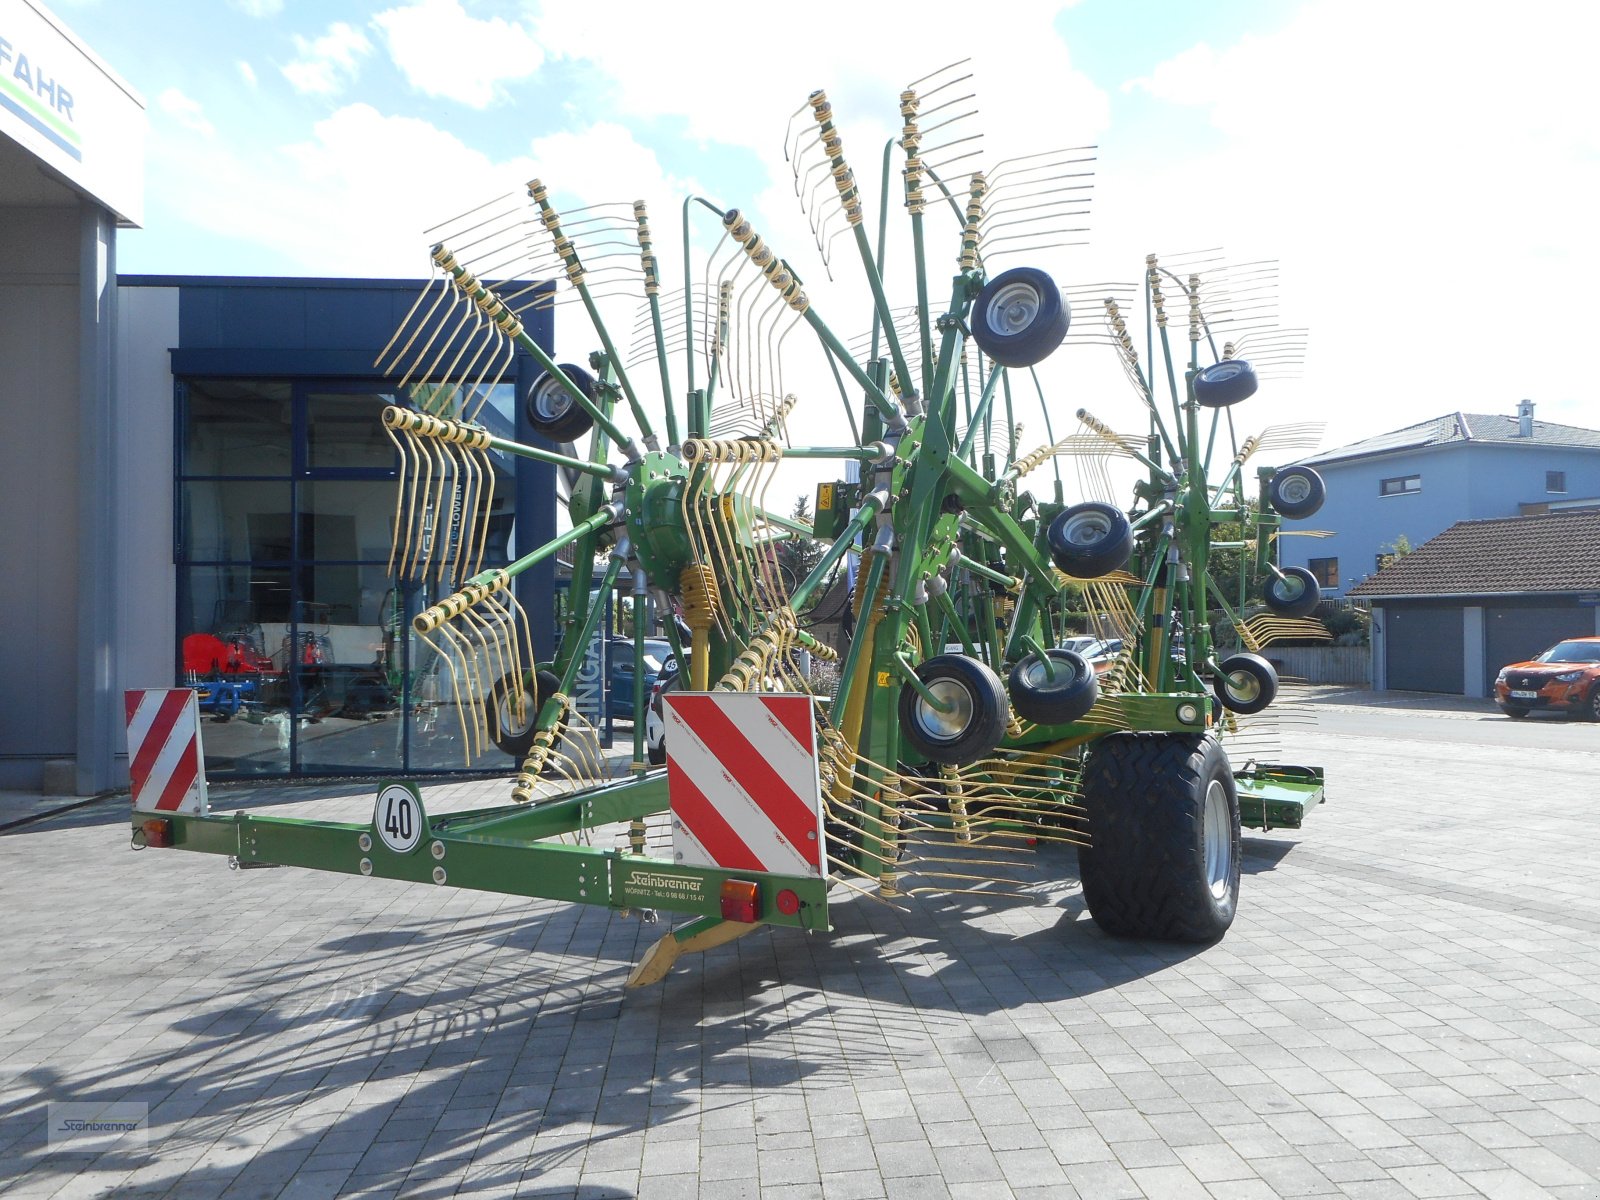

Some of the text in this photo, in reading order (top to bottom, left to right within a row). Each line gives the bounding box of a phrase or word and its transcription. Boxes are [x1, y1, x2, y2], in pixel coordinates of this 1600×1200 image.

[667, 661, 676, 669] 45
[385, 798, 411, 839] 40
[625, 871, 703, 891] Steinbrenner
